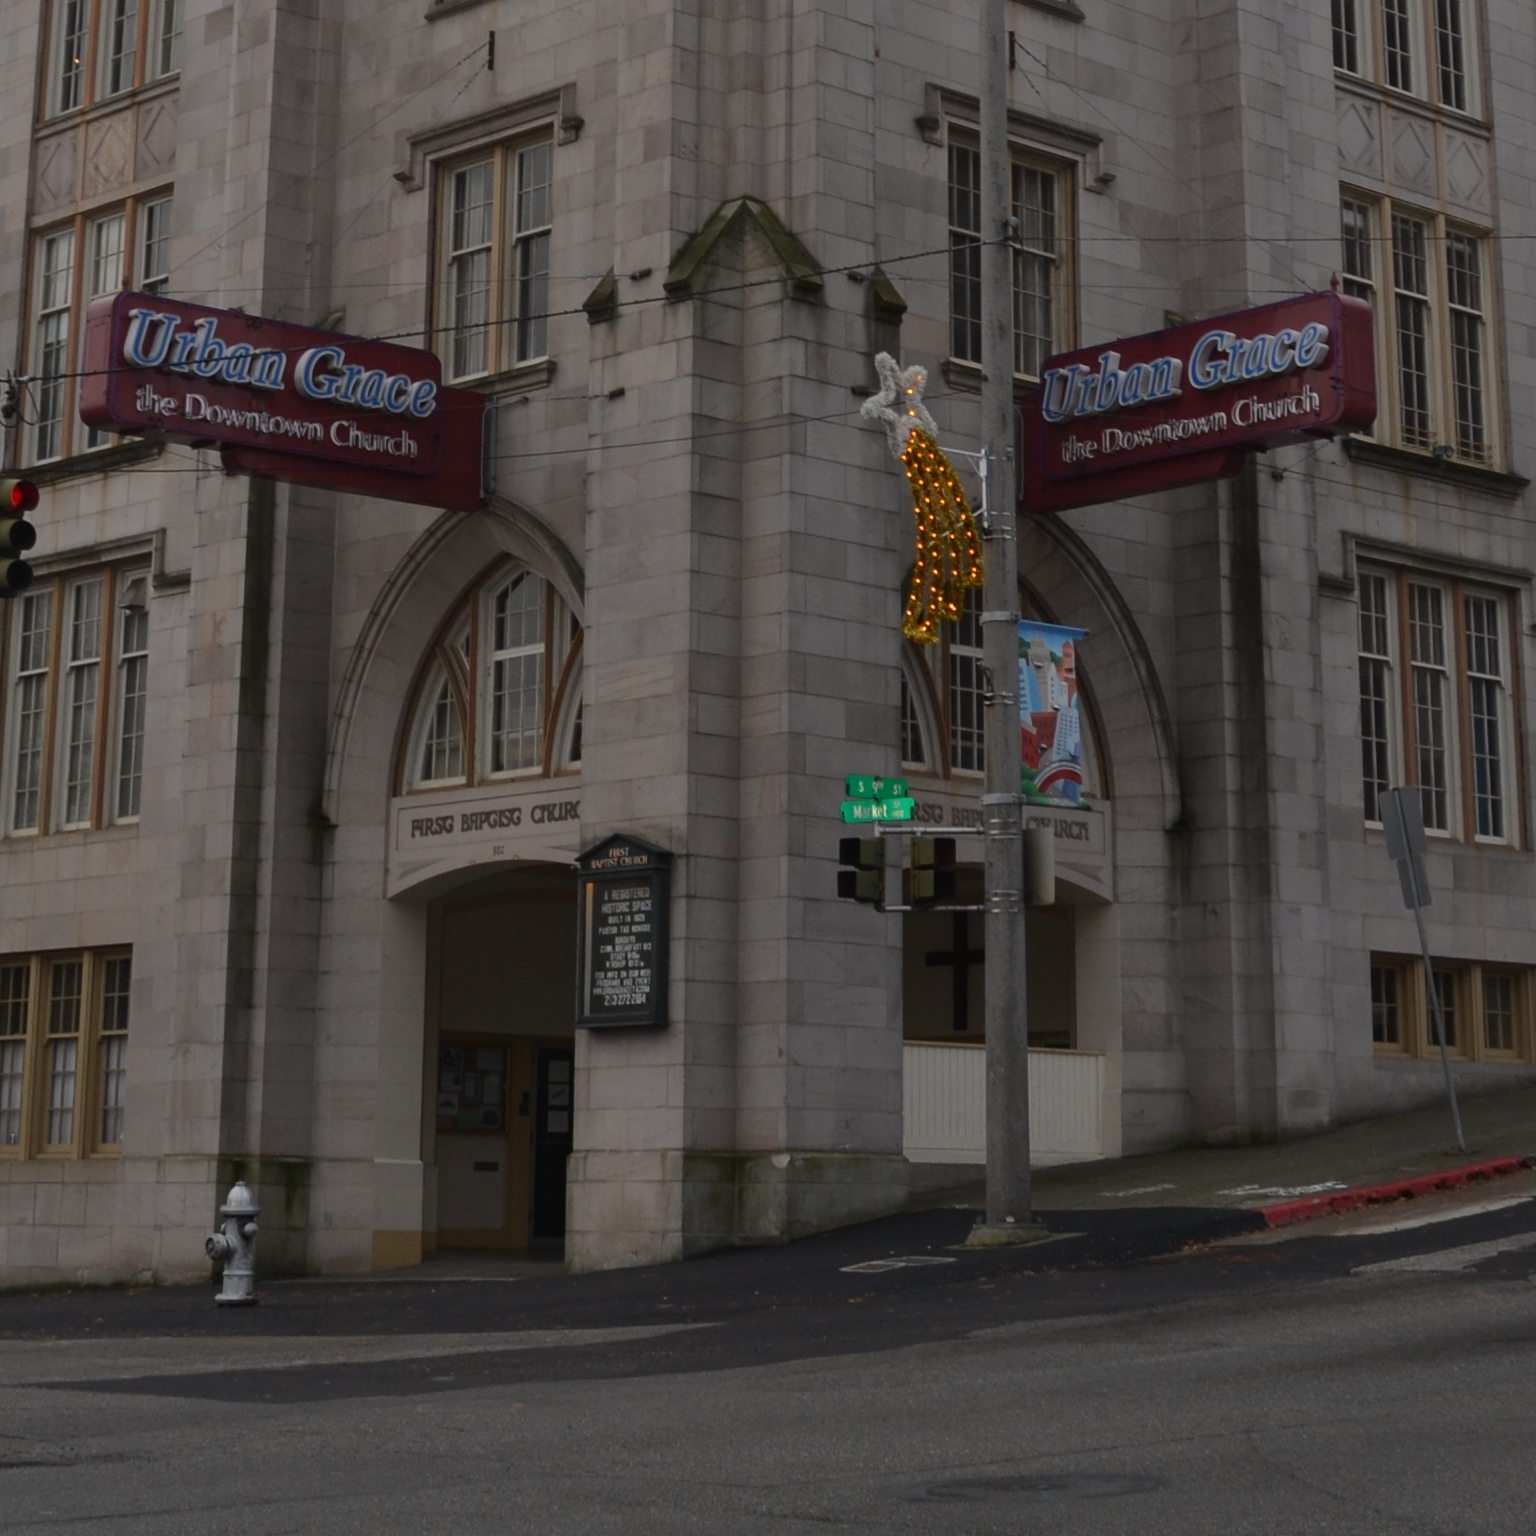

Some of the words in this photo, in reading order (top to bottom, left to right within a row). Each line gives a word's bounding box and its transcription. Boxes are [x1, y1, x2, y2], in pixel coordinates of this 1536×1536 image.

[124, 308, 286, 391] Urban
[295, 346, 437, 418] Grace
[1042, 351, 1183, 423] Urban
[1188, 322, 1330, 391] Grace
[136, 384, 178, 417] the
[185, 393, 324, 441] Downtown
[330, 420, 418, 458] Church
[1062, 435, 1098, 463] the
[1102, 411, 1227, 454] Downtown
[1231, 385, 1320, 427] Church
[858, 780, 865, 794] S
[893, 784, 902, 796] ST
[411, 814, 454, 838] FIRST
[461, 807, 522, 833] BAPTIST
[530, 800, 581, 824] CHURC
[853, 803, 888, 819] Market
[591, 857, 618, 869] BAPTIST
[620, 855, 648, 866] CHURCH
[609, 847, 630, 858] FIRST
[601, 902, 630, 914] HISTORIC
[632, 899, 652, 912] SPACE
